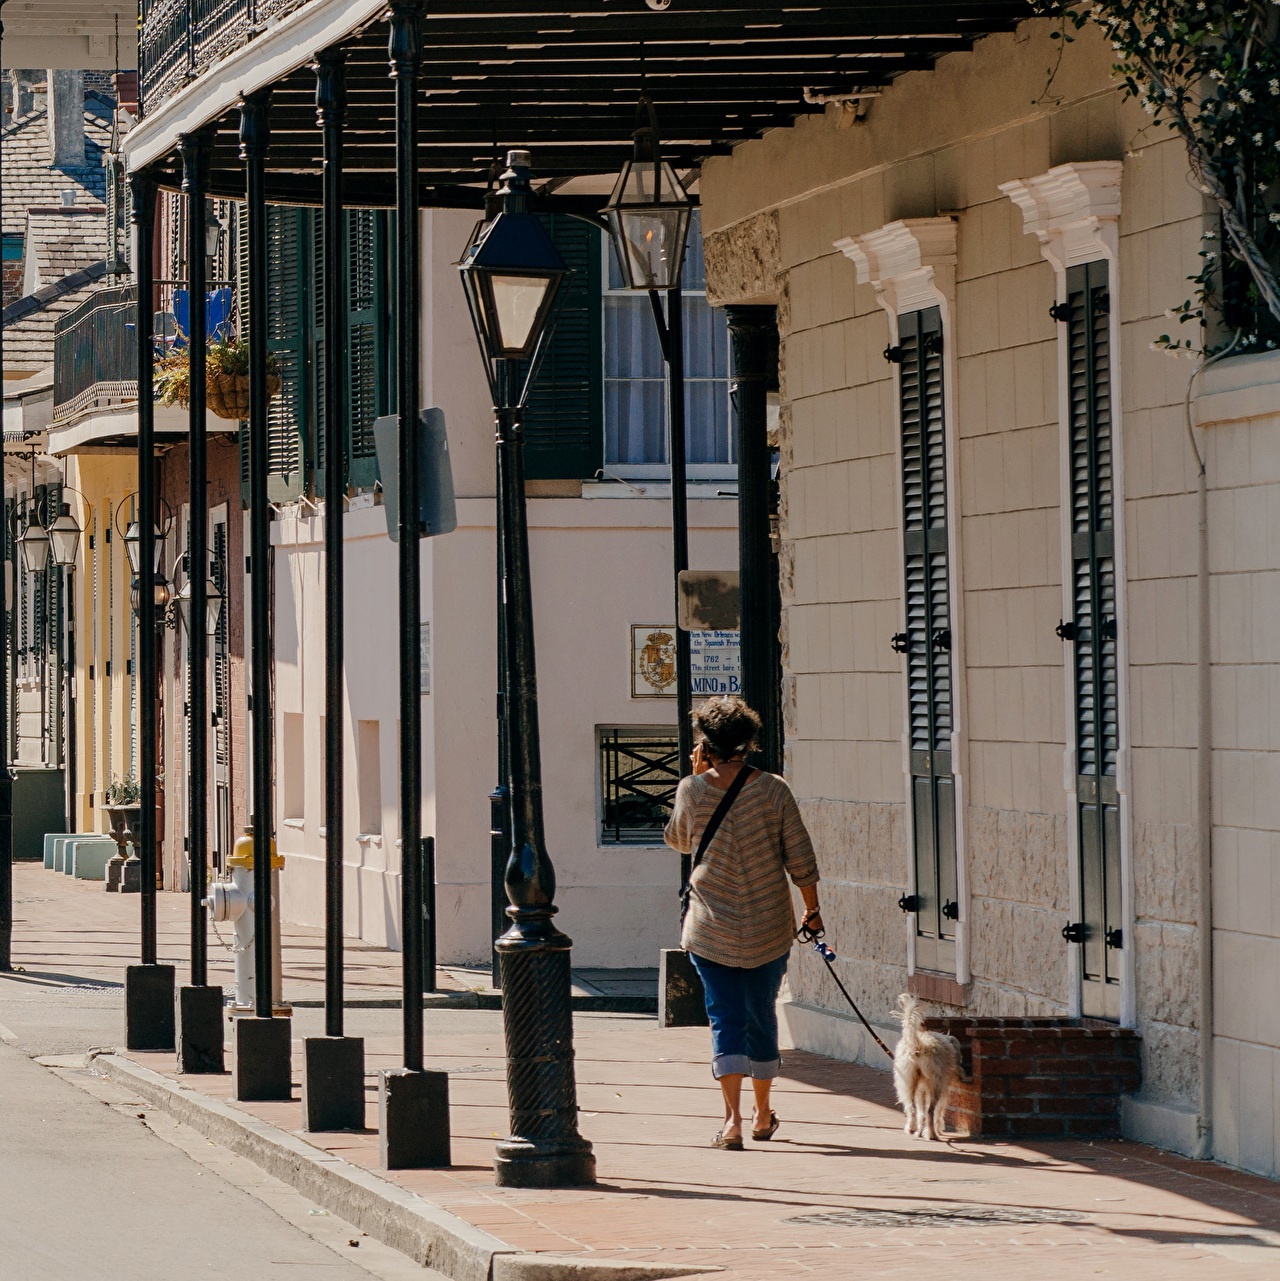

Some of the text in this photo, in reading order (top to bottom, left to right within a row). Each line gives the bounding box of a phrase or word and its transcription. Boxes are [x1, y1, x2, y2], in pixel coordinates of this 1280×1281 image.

[714, 630, 734, 638] Orleans
[705, 639, 724, 648] Spanish
[704, 655, 719, 663] 1762
